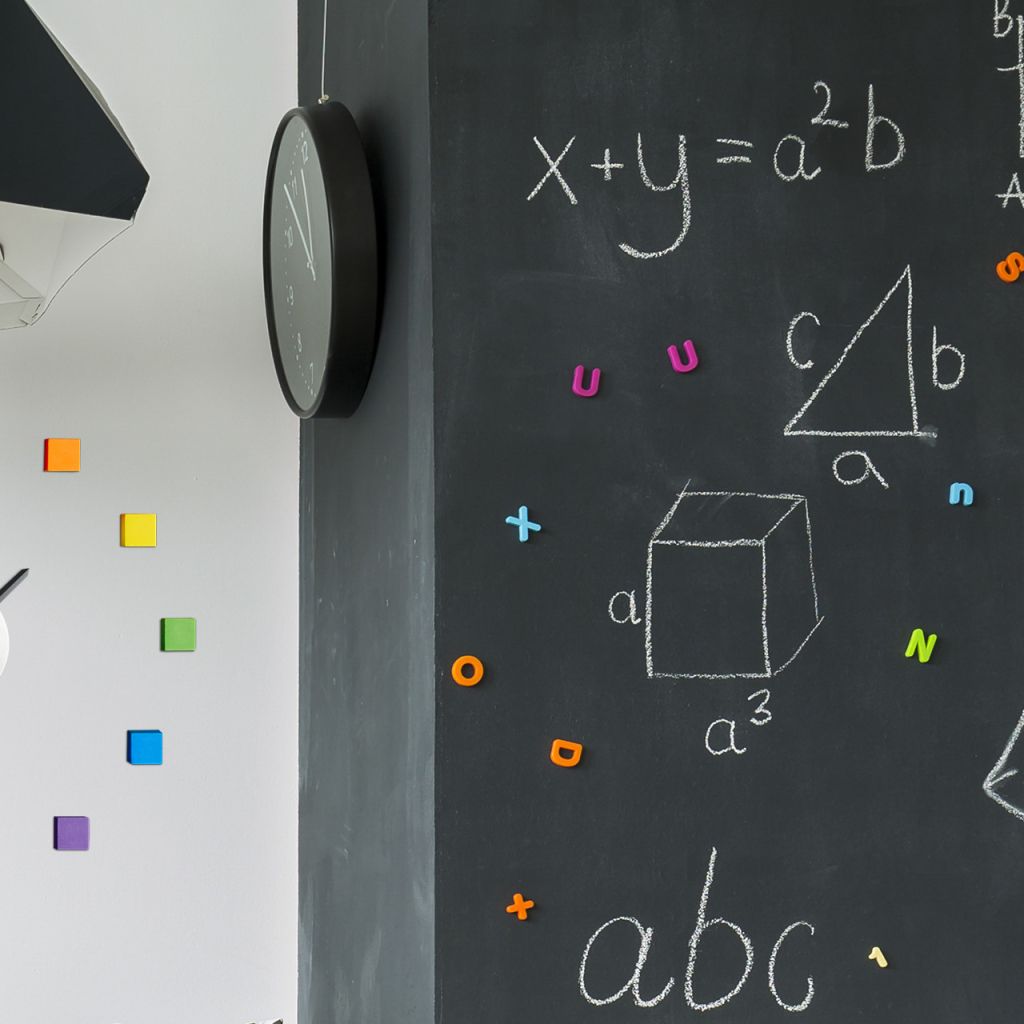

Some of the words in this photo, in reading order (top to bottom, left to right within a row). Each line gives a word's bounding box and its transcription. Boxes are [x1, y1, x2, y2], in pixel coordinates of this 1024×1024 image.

[931, 326, 966, 391] b
[832, 450, 890, 489] a
[608, 590, 642, 625] a
[905, 629, 938, 663] N
[579, 847, 816, 1012] abc
